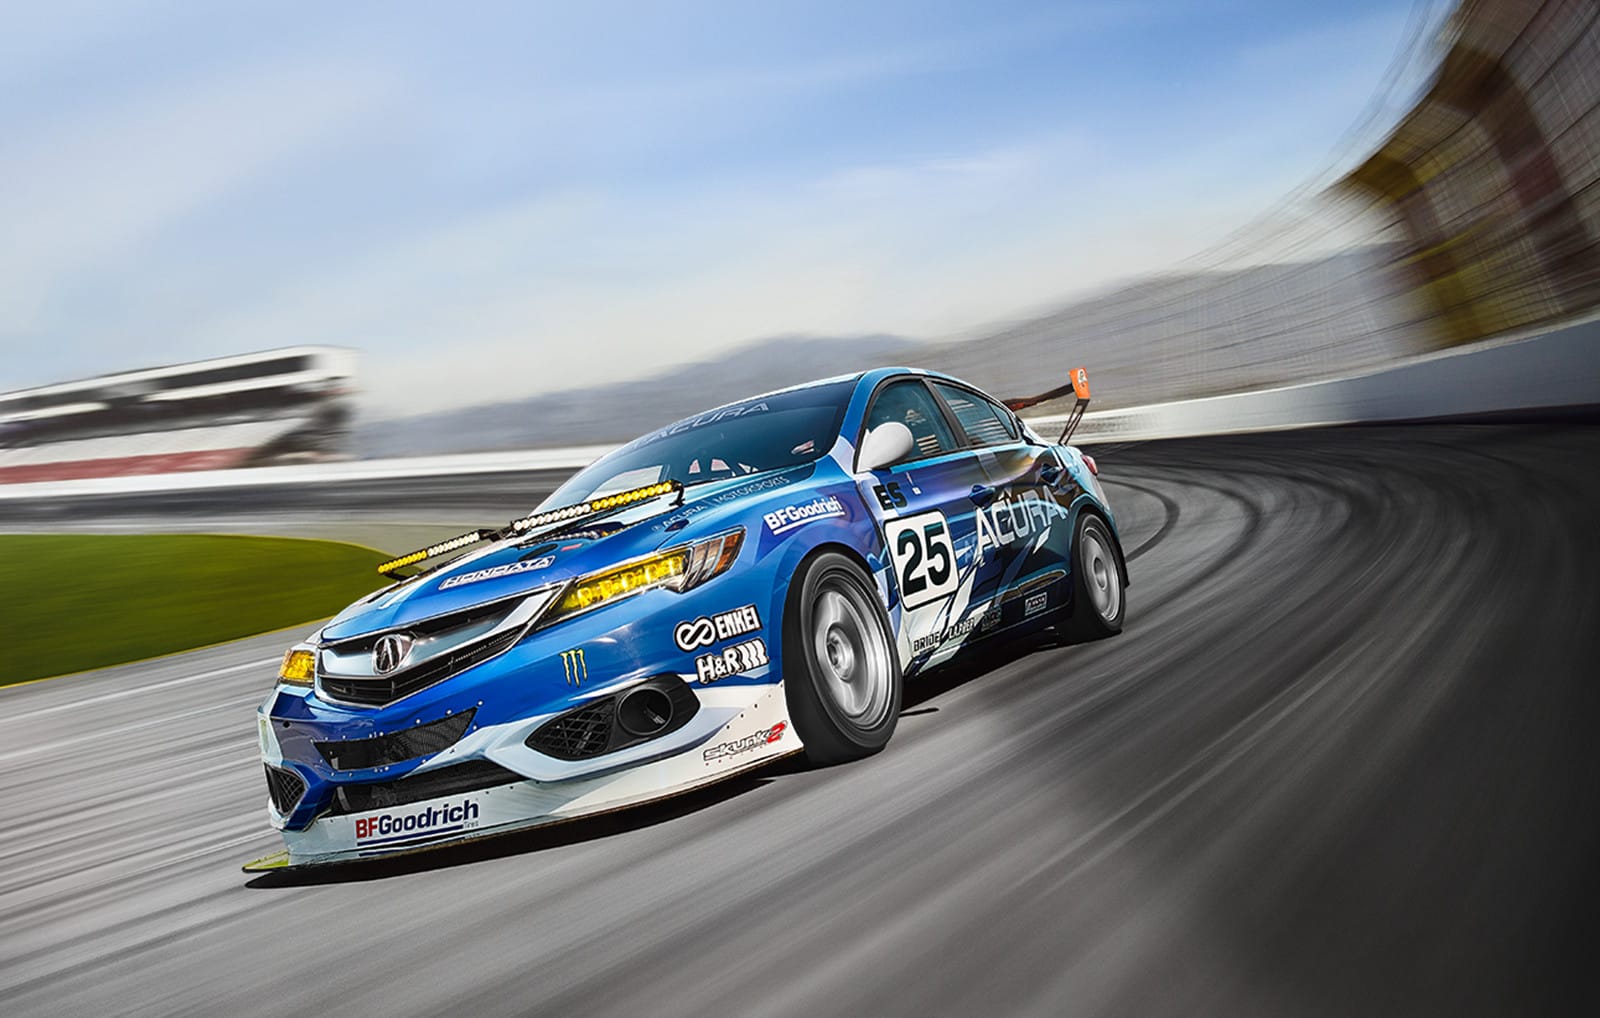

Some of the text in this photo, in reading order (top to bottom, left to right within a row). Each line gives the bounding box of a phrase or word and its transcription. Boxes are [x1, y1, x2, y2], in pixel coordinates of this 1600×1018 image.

[642, 403, 769, 443] ACURA
[763, 496, 842, 530] BFGoodrich
[873, 482, 908, 511] ES
[662, 504, 707, 528] ACURA
[976, 485, 1068, 550] ACURA
[439, 556, 555, 589] HONDATA
[897, 521, 951, 598] 25
[714, 605, 762, 640] ENKEI
[913, 631, 941, 651] BRIDE
[356, 800, 478, 839] BFGoodrich
